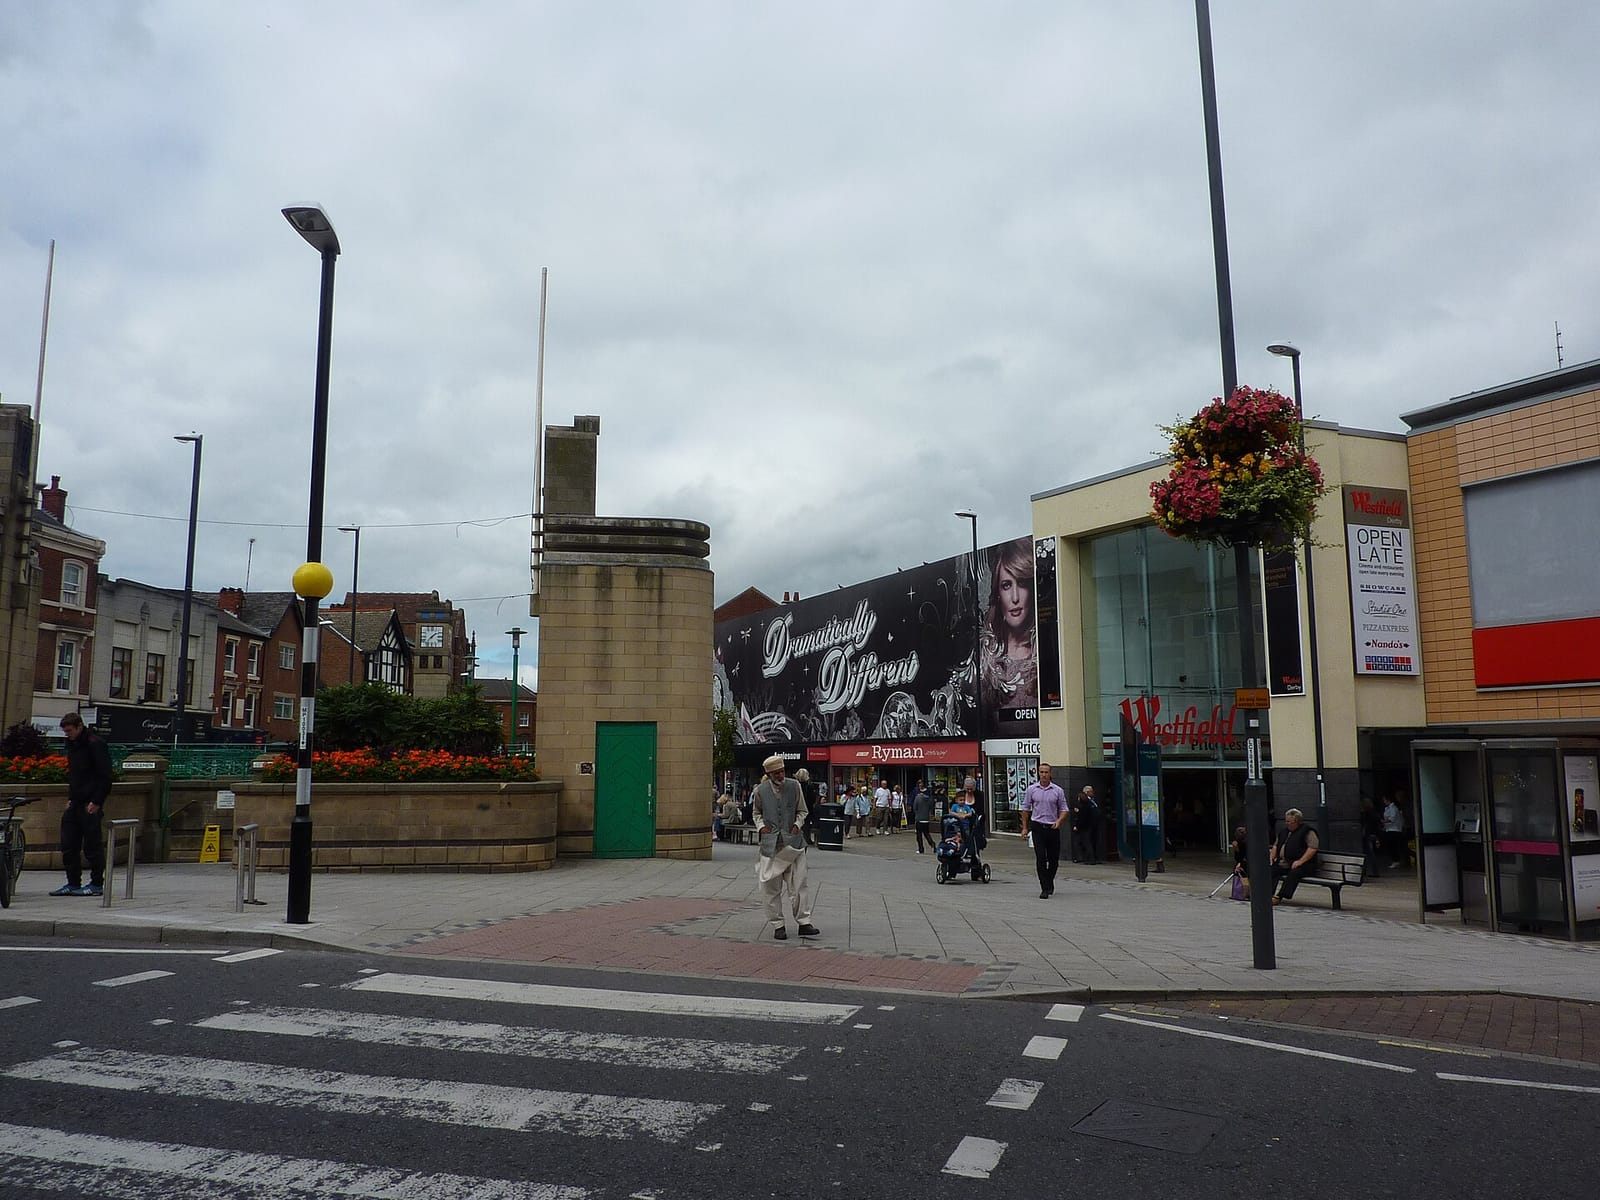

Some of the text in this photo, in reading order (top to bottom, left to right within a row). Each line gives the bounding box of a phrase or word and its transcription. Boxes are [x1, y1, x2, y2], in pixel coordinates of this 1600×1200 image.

[1351, 490, 1404, 516] Westfield
[1357, 528, 1402, 547] OPEN
[1358, 546, 1404, 564] LATE
[1362, 600, 1407, 616] Studio One
[1362, 623, 1409, 633] PIZZAEXPRESS
[762, 597, 878, 679] Dramatically
[1371, 640, 1404, 649] Nando's
[817, 641, 920, 715] Different
[1015, 709, 1037, 720] OPEN
[1119, 695, 1237, 746] Westfield
[871, 745, 924, 761] Ryman
